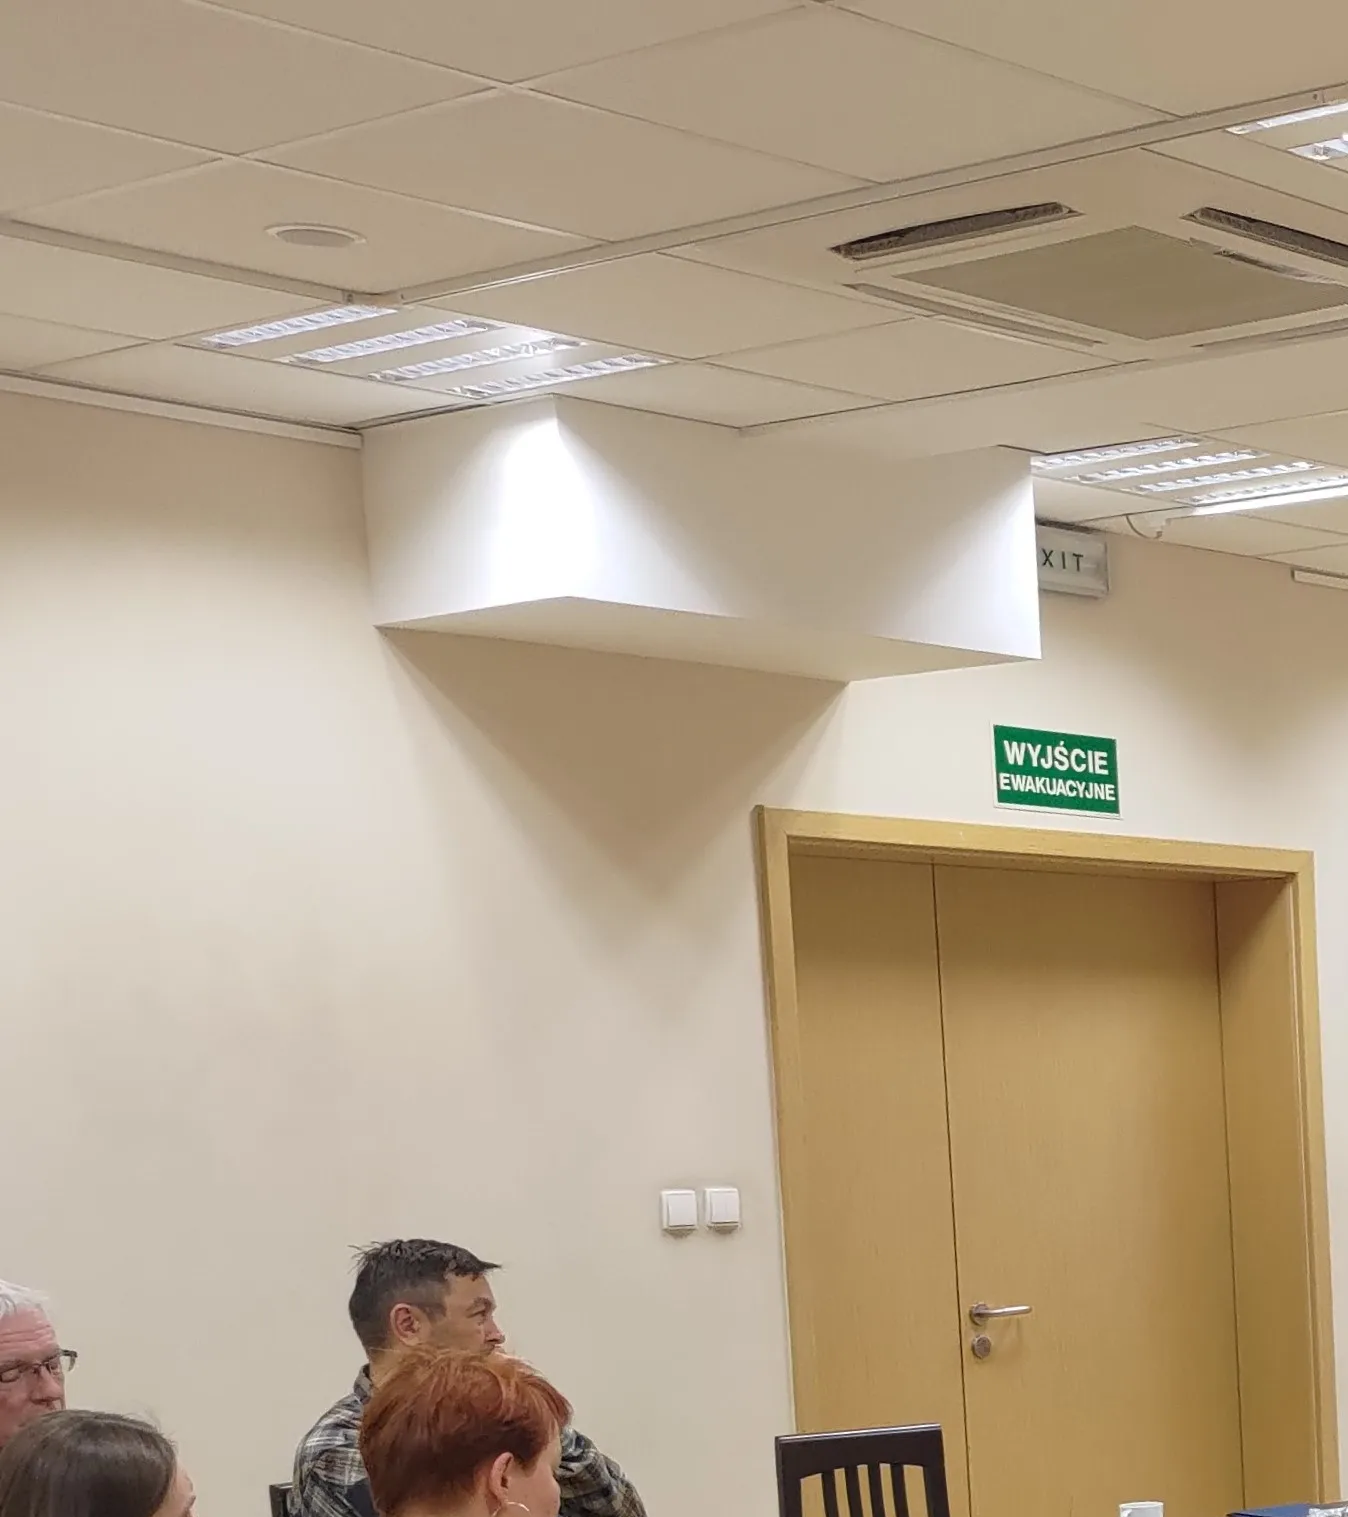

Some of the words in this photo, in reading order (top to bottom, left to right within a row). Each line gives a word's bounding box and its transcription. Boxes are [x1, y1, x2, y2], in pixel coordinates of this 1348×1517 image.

[1041, 547, 1084, 572] XIT
[1003, 740, 1109, 775] WYJŚCIE
[999, 772, 1116, 801] EWAKUACYJNE
